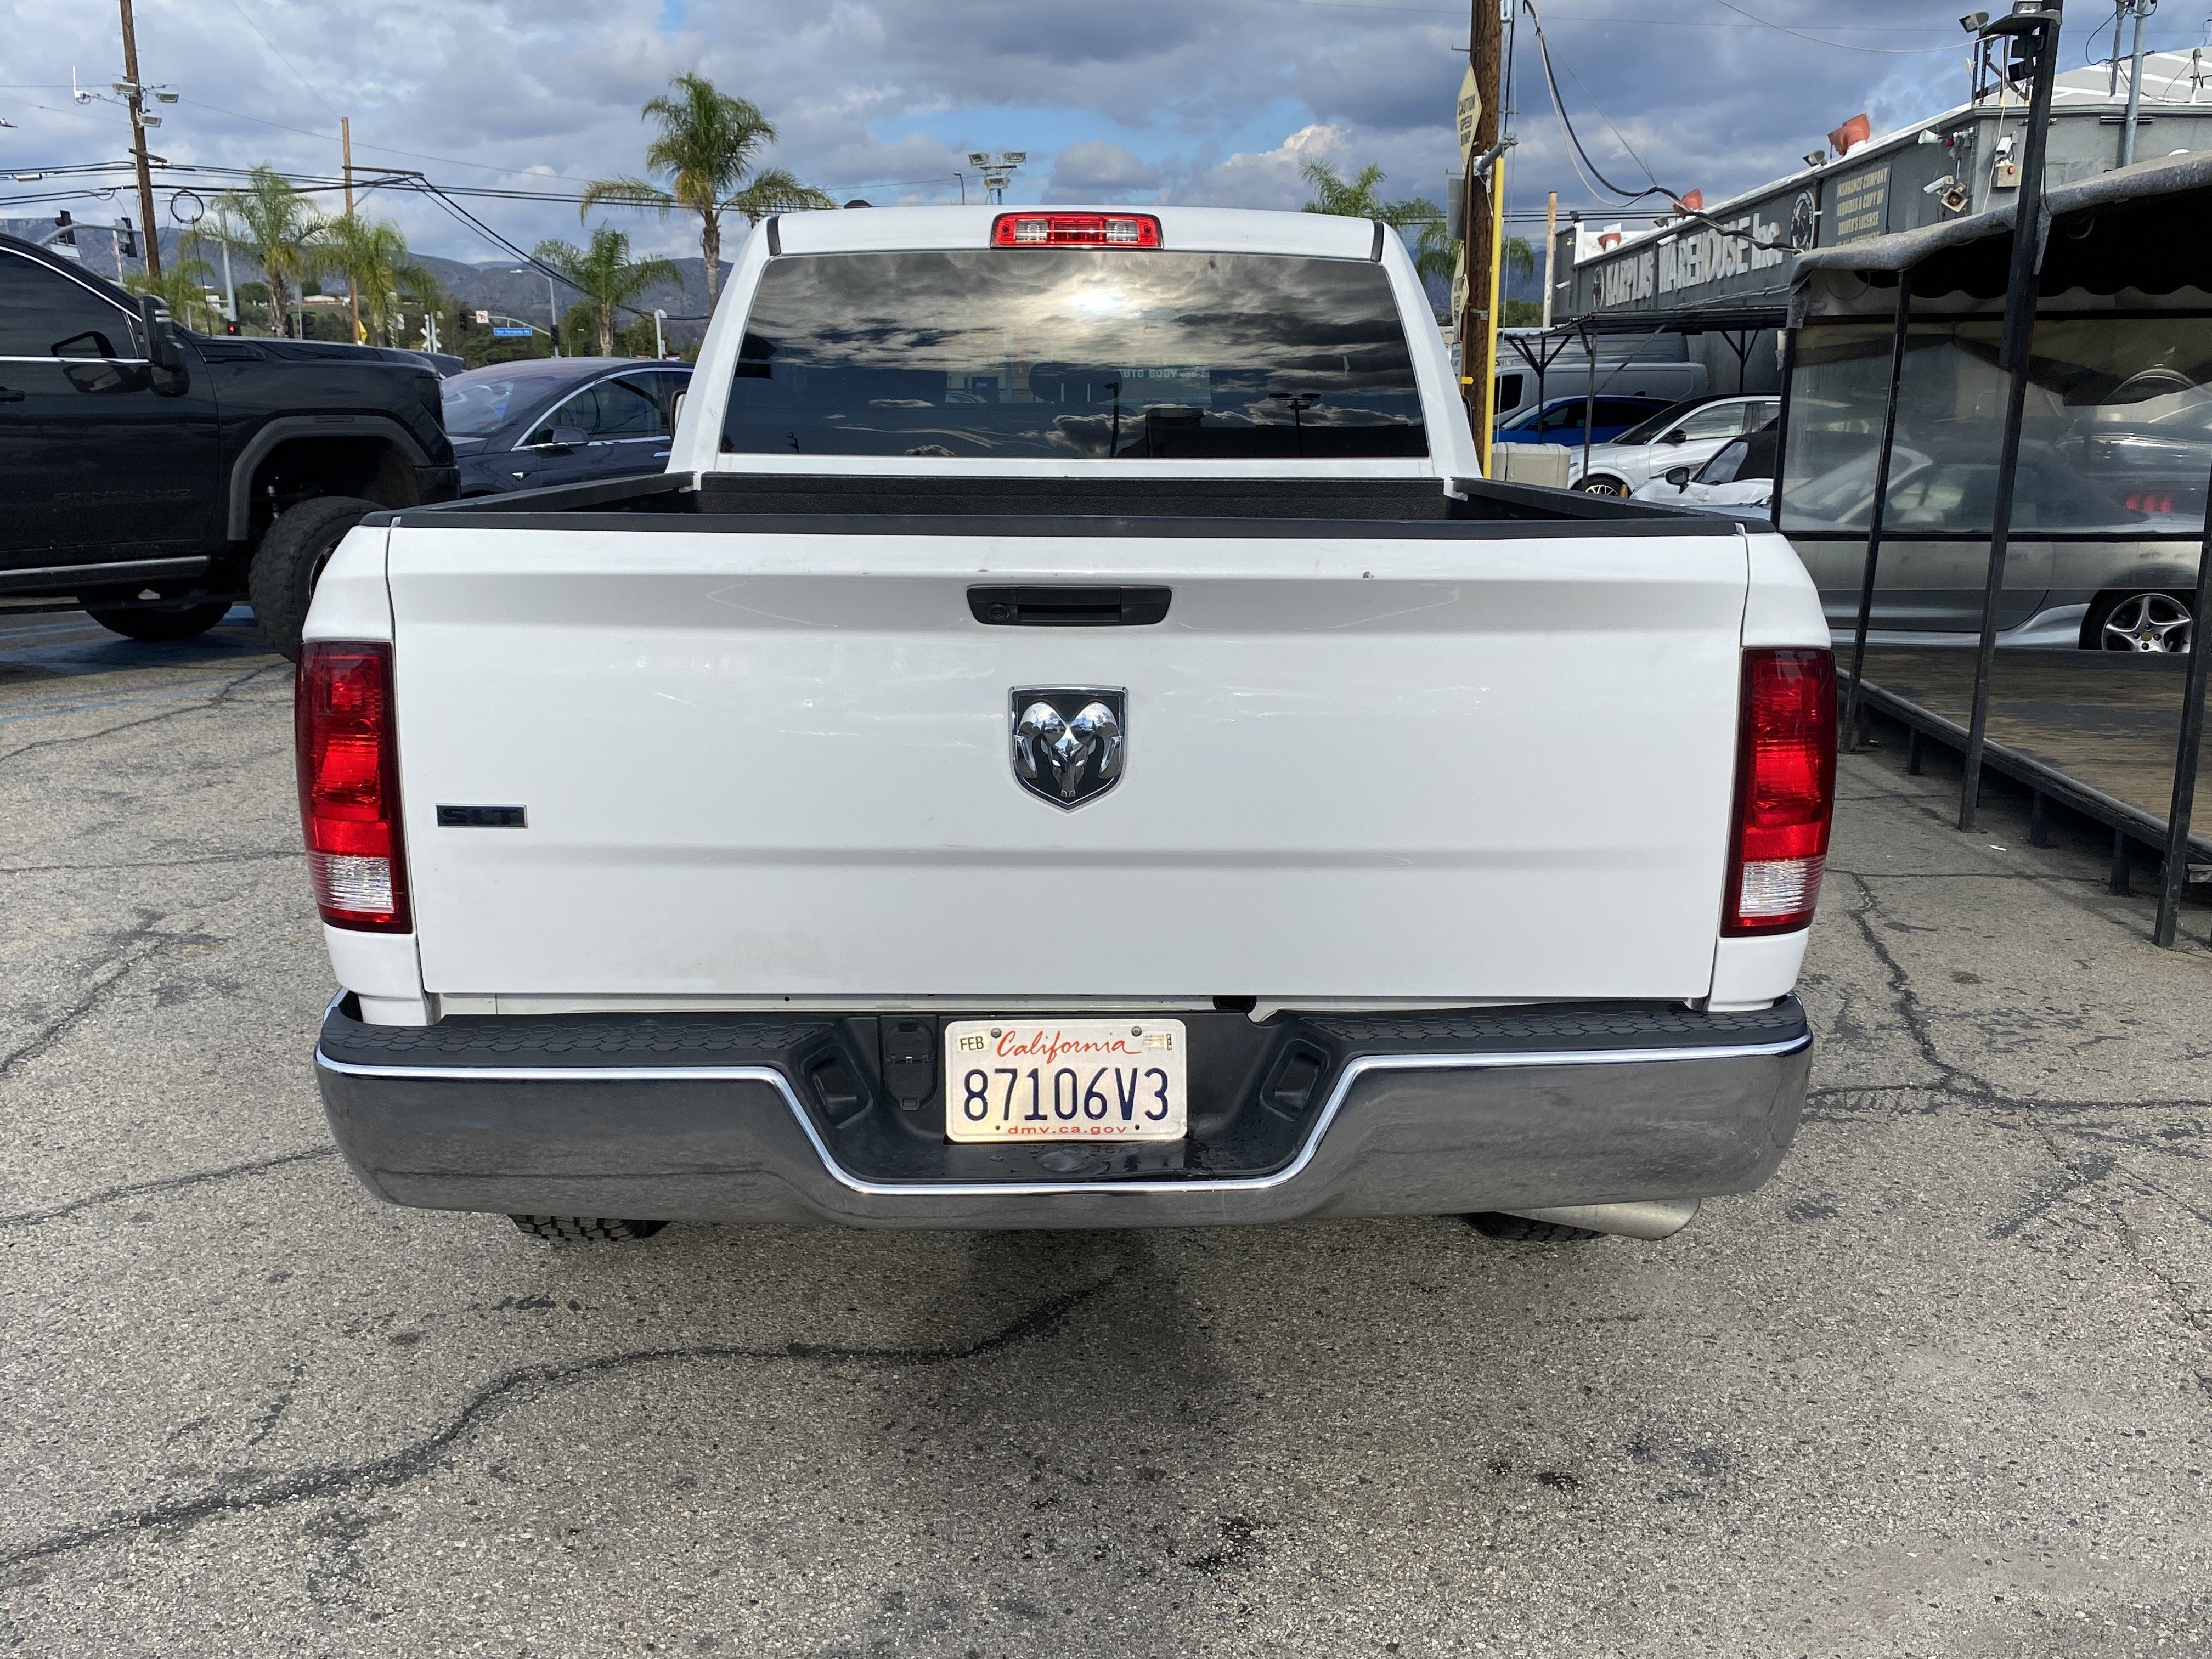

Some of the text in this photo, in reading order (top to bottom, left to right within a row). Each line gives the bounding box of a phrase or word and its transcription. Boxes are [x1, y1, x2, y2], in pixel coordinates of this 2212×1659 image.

[1459, 93, 1476, 116] CAUTION
[1460, 114, 1472, 132] SPEED
[1658, 216, 1751, 294] WAREHOUSE
[1149, 369, 1177, 378] BODY
[443, 808, 518, 825] SLT
[960, 1030, 1142, 1065] FEB California
[964, 1067, 1169, 1121] 87106V3
[1007, 1125, 1127, 1135] dmv.ca.gov
